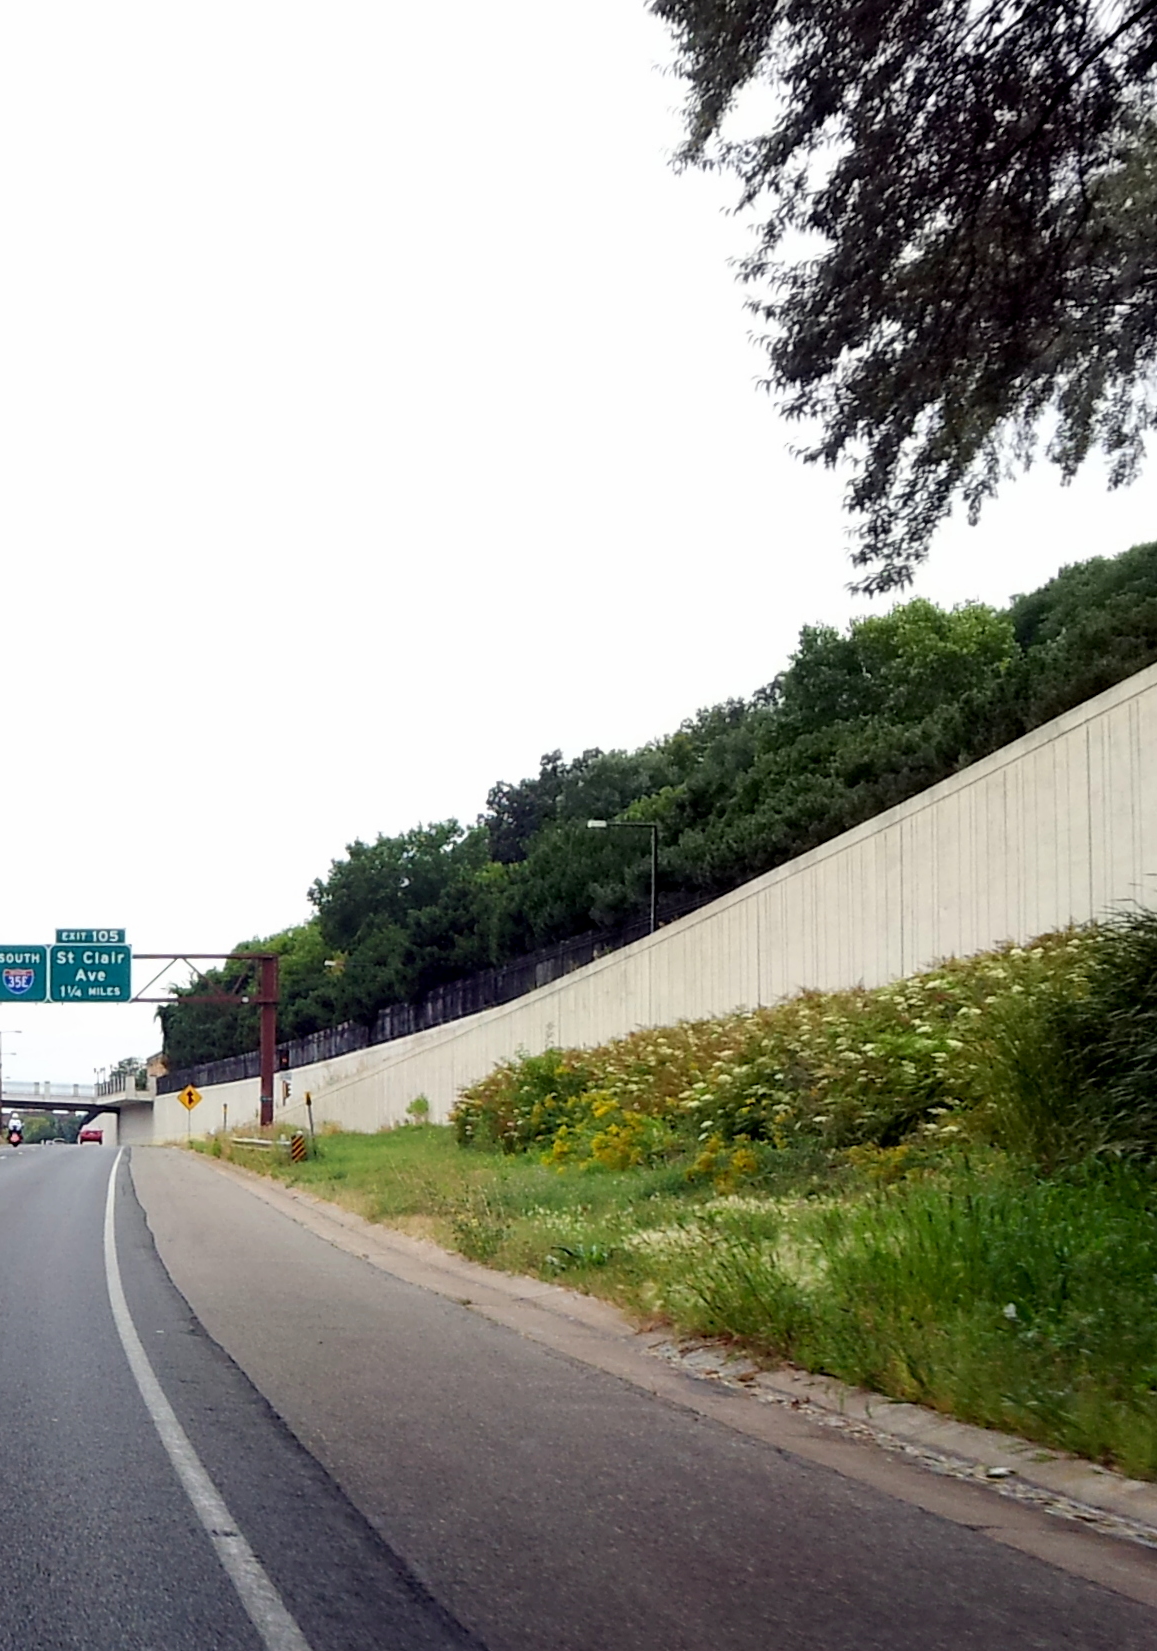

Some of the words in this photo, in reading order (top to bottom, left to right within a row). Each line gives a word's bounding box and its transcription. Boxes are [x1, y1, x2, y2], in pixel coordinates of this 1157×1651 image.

[61, 932, 87, 941] EXIT
[92, 930, 119, 942] 105
[56, 951, 75, 964] St
[83, 951, 125, 964] Clair
[75, 968, 106, 982] Ave
[8, 976, 29, 988] 35E
[88, 987, 121, 996] MILES
